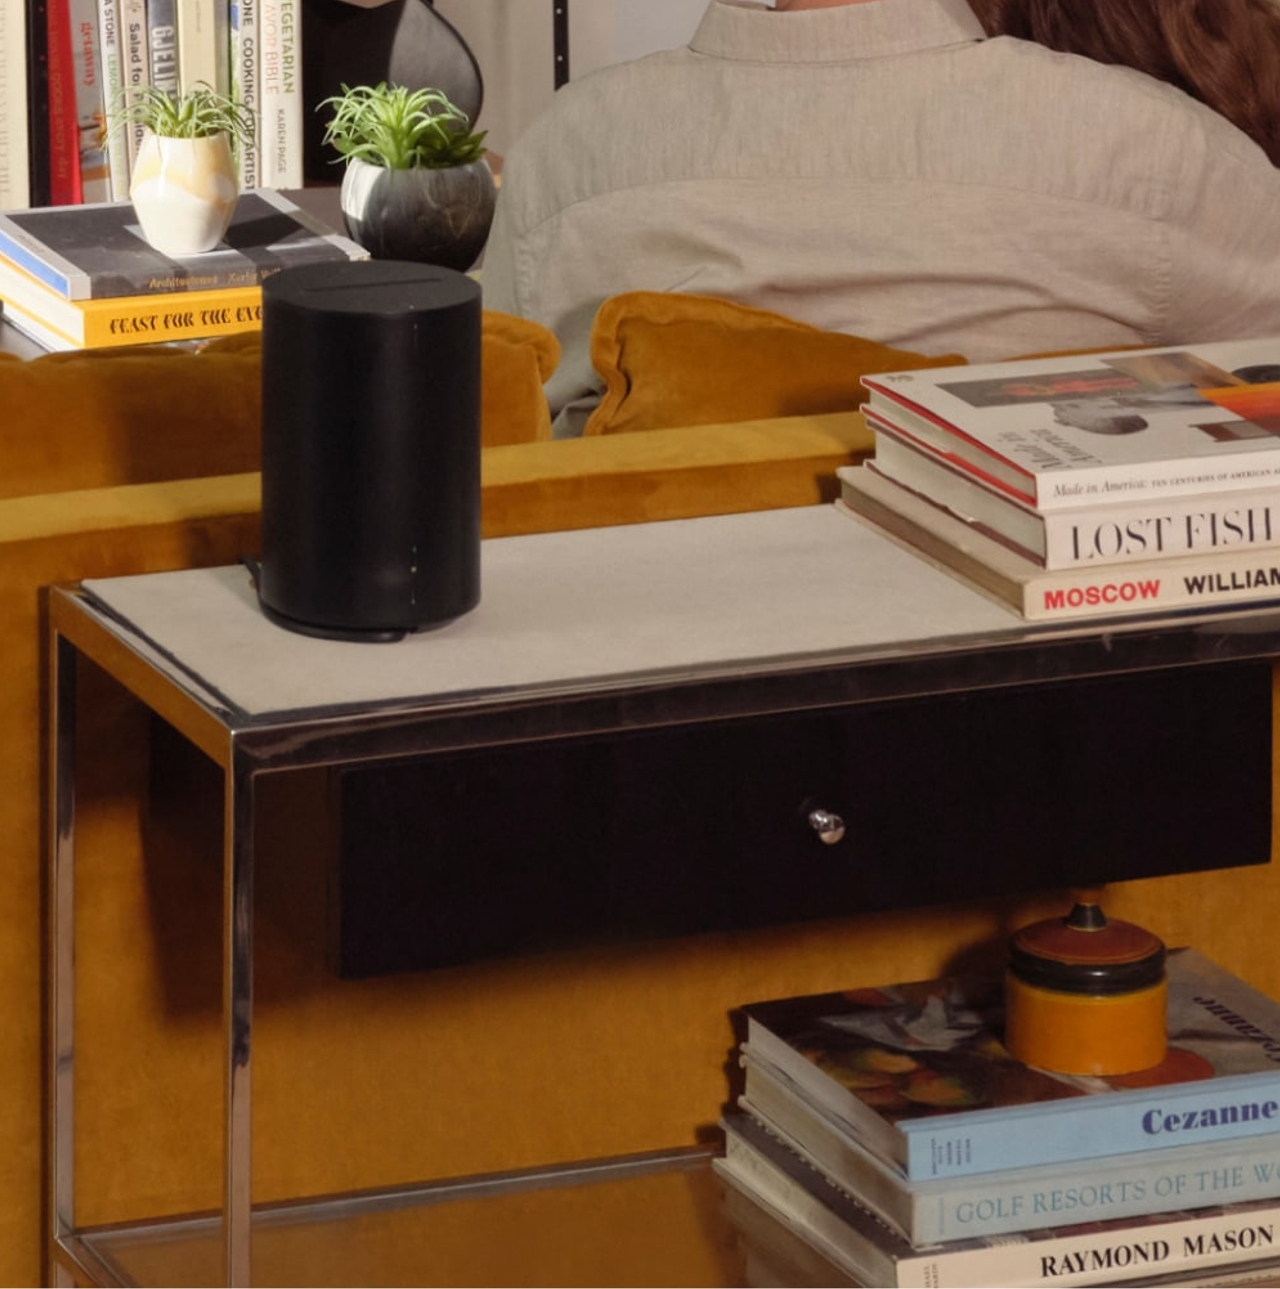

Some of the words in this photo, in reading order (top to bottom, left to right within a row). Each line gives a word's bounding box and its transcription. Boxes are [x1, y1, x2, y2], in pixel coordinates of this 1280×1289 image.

[104, 8, 115, 47] STONE
[129, 23, 141, 62] Salad
[80, 22, 96, 87] getaway
[151, 25, 178, 101] GJELIN
[243, 37, 255, 106] COOKING
[265, 51, 280, 95] BIBLE
[131, 67, 141, 86] for
[277, 109, 286, 144] KAREN
[245, 143, 256, 191] ARTIST
[277, 147, 287, 174] PAGE
[110, 315, 159, 334] FEAST
[163, 312, 194, 329] FOR
[200, 308, 231, 326] THE
[236, 305, 263, 322] EYE
[1053, 484, 1085, 498] Made
[1086, 482, 1098, 494] in
[1101, 479, 1148, 494] America:
[1151, 479, 1167, 488] TEN
[1170, 474, 1216, 486] CENTURIES
[1217, 473, 1228, 481] OF
[1230, 468, 1272, 479] AMERICAN
[1072, 516, 1173, 561] LOST
[1184, 507, 1272, 549] FISH
[1044, 579, 1161, 610] MOSCOW
[1141, 1099, 1279, 1136] Cezanne
[955, 1195, 1024, 1224] GOLF
[1032, 1181, 1147, 1213] RESORTS
[1155, 1174, 1187, 1197] OF
[1199, 1165, 1244, 1191] THE
[1040, 1238, 1171, 1278] RAYMOND
[1182, 1223, 1275, 1258] MASON
